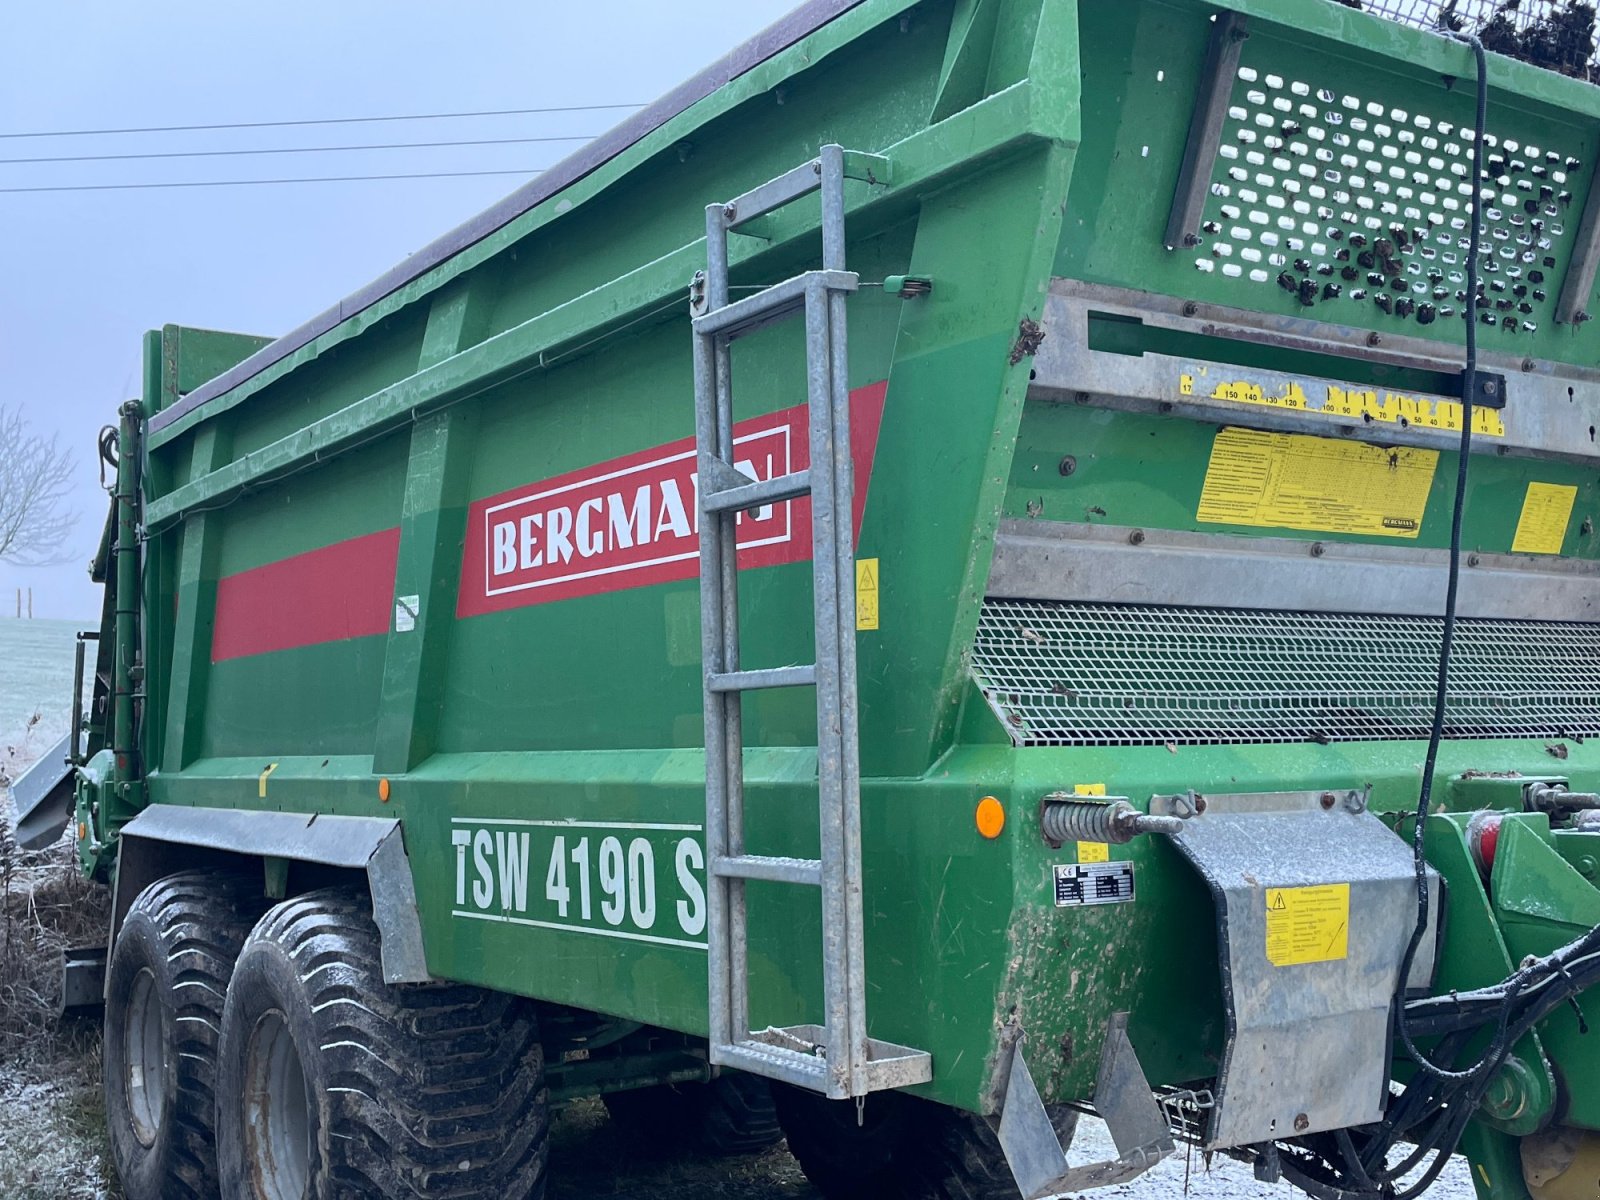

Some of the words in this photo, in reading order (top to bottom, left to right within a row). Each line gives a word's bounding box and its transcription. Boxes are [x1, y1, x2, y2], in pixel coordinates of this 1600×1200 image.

[1225, 390, 1238, 399] 150
[1244, 392, 1258, 401] 140
[1265, 396, 1278, 404] 130
[1284, 399, 1297, 407] 120
[1323, 404, 1335, 412] 100
[1342, 407, 1351, 415] 90
[1379, 411, 1387, 419] 70
[1414, 416, 1422, 424] 50
[1430, 418, 1438, 426] 40
[1447, 420, 1455, 428] 30
[1481, 425, 1488, 433] 10
[493, 453, 773, 576] BERGMAN
[451, 828, 530, 912] TSW
[546, 835, 656, 930] 4190
[675, 837, 706, 936] S
